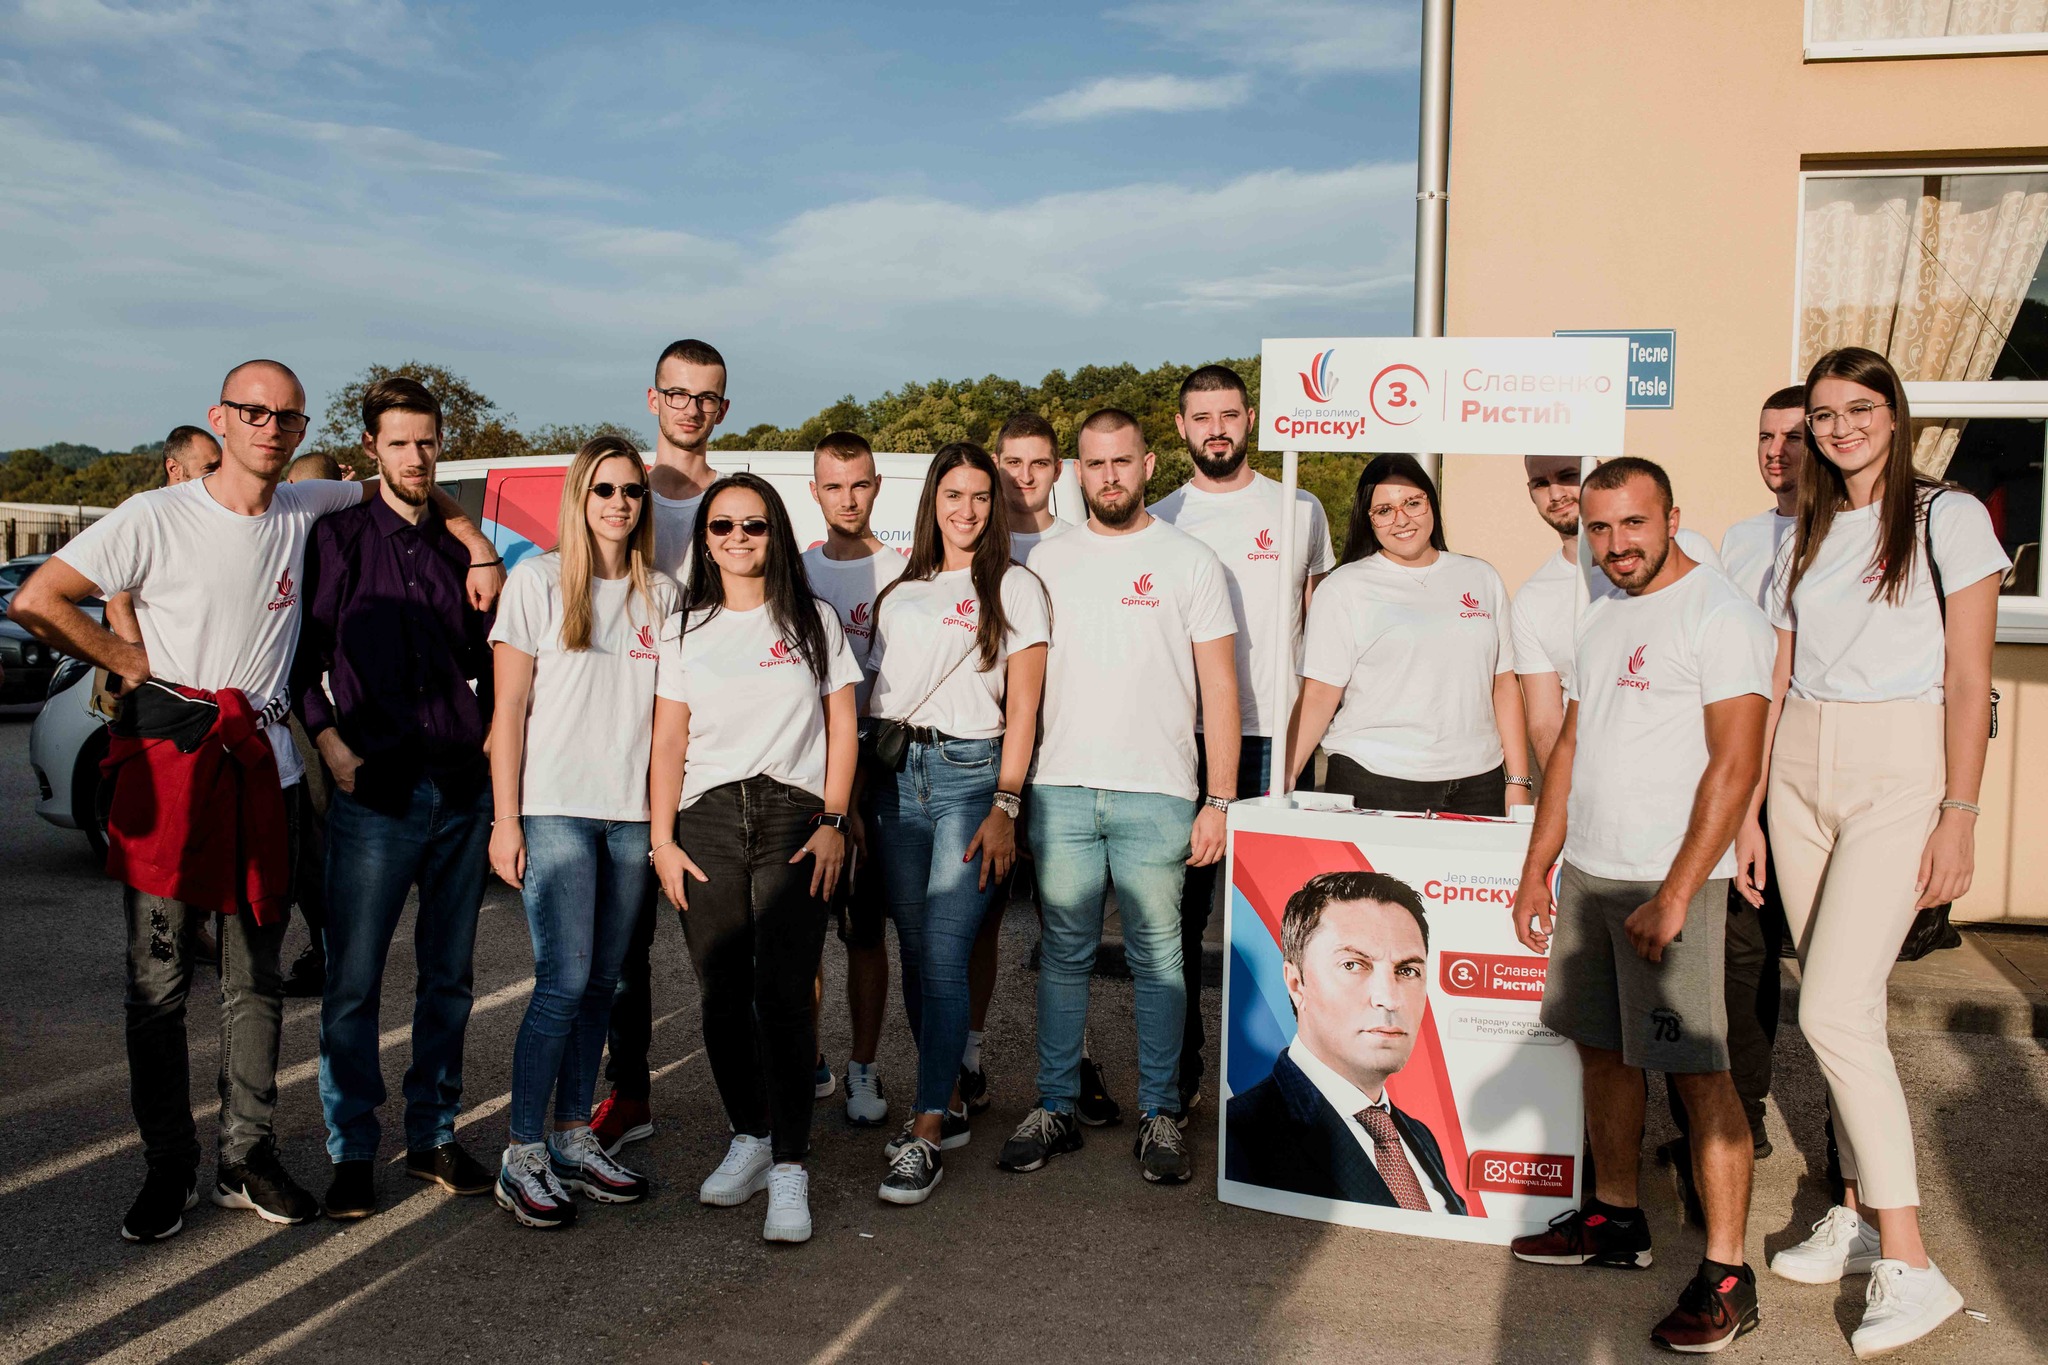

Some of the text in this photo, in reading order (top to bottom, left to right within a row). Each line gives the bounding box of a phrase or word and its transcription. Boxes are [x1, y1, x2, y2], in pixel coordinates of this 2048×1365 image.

[1630, 342, 1669, 363] Тесле
[1463, 368, 1612, 394] Славенко
[1629, 376, 1668, 396] Tesle
[1387, 381, 1417, 408] 3.
[1291, 407, 1360, 419] Јер волимо
[1461, 399, 1571, 424] Ристић
[1274, 415, 1366, 440] Српску!
[1247, 552, 1280, 561] Српску
[1121, 597, 1160, 608] Српску!
[942, 617, 978, 632] Српску!
[1443, 872, 1520, 886] Јер волимо
[1424, 880, 1519, 909] Српску
[1457, 963, 1547, 981] 3. Славен
[1470, 1016, 1510, 1028] Народну
[1476, 1025, 1560, 1038] Републике Српске
[1508, 1161, 1563, 1180] СНСД
[1507, 1177, 1540, 1187] Милорад
